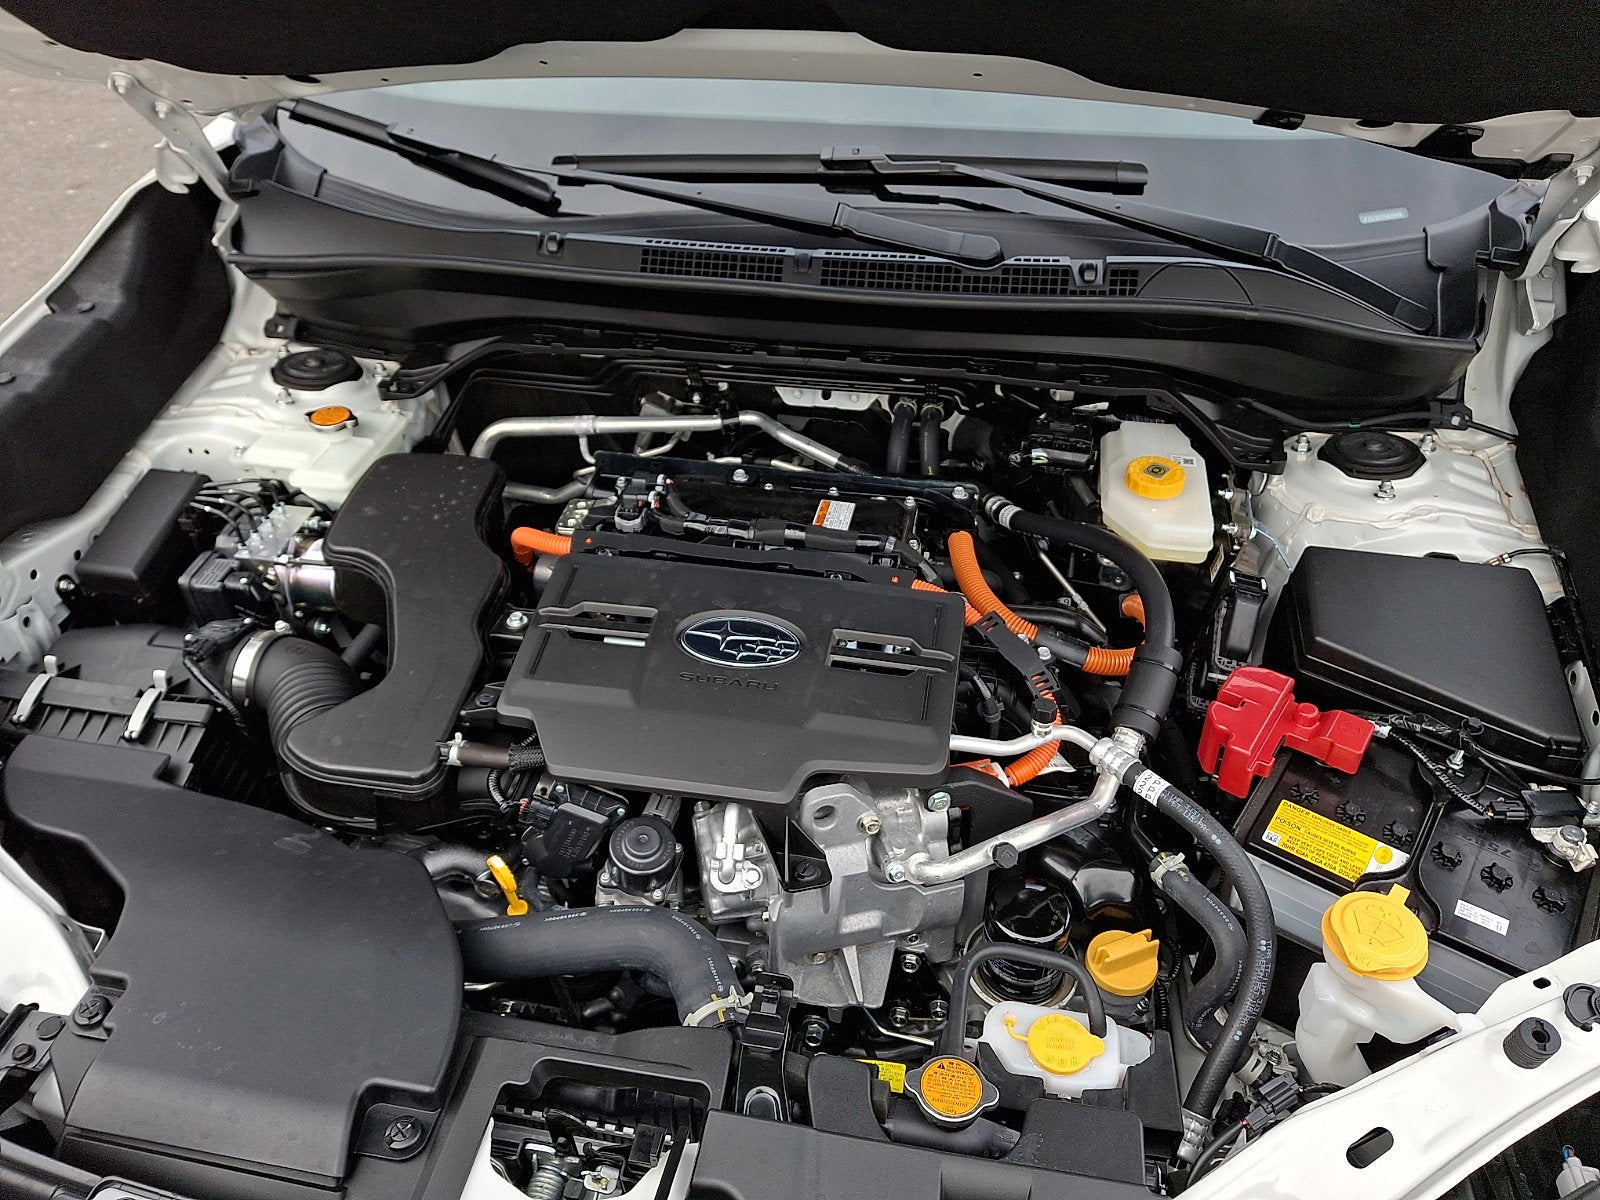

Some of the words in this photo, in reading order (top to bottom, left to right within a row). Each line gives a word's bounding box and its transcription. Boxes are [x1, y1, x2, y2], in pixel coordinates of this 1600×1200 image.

[679, 671, 779, 691] SUBARU
[1282, 801, 1310, 817] DANGER
[1275, 816, 1301, 831] POISON
[1310, 856, 1323, 866] CCA
